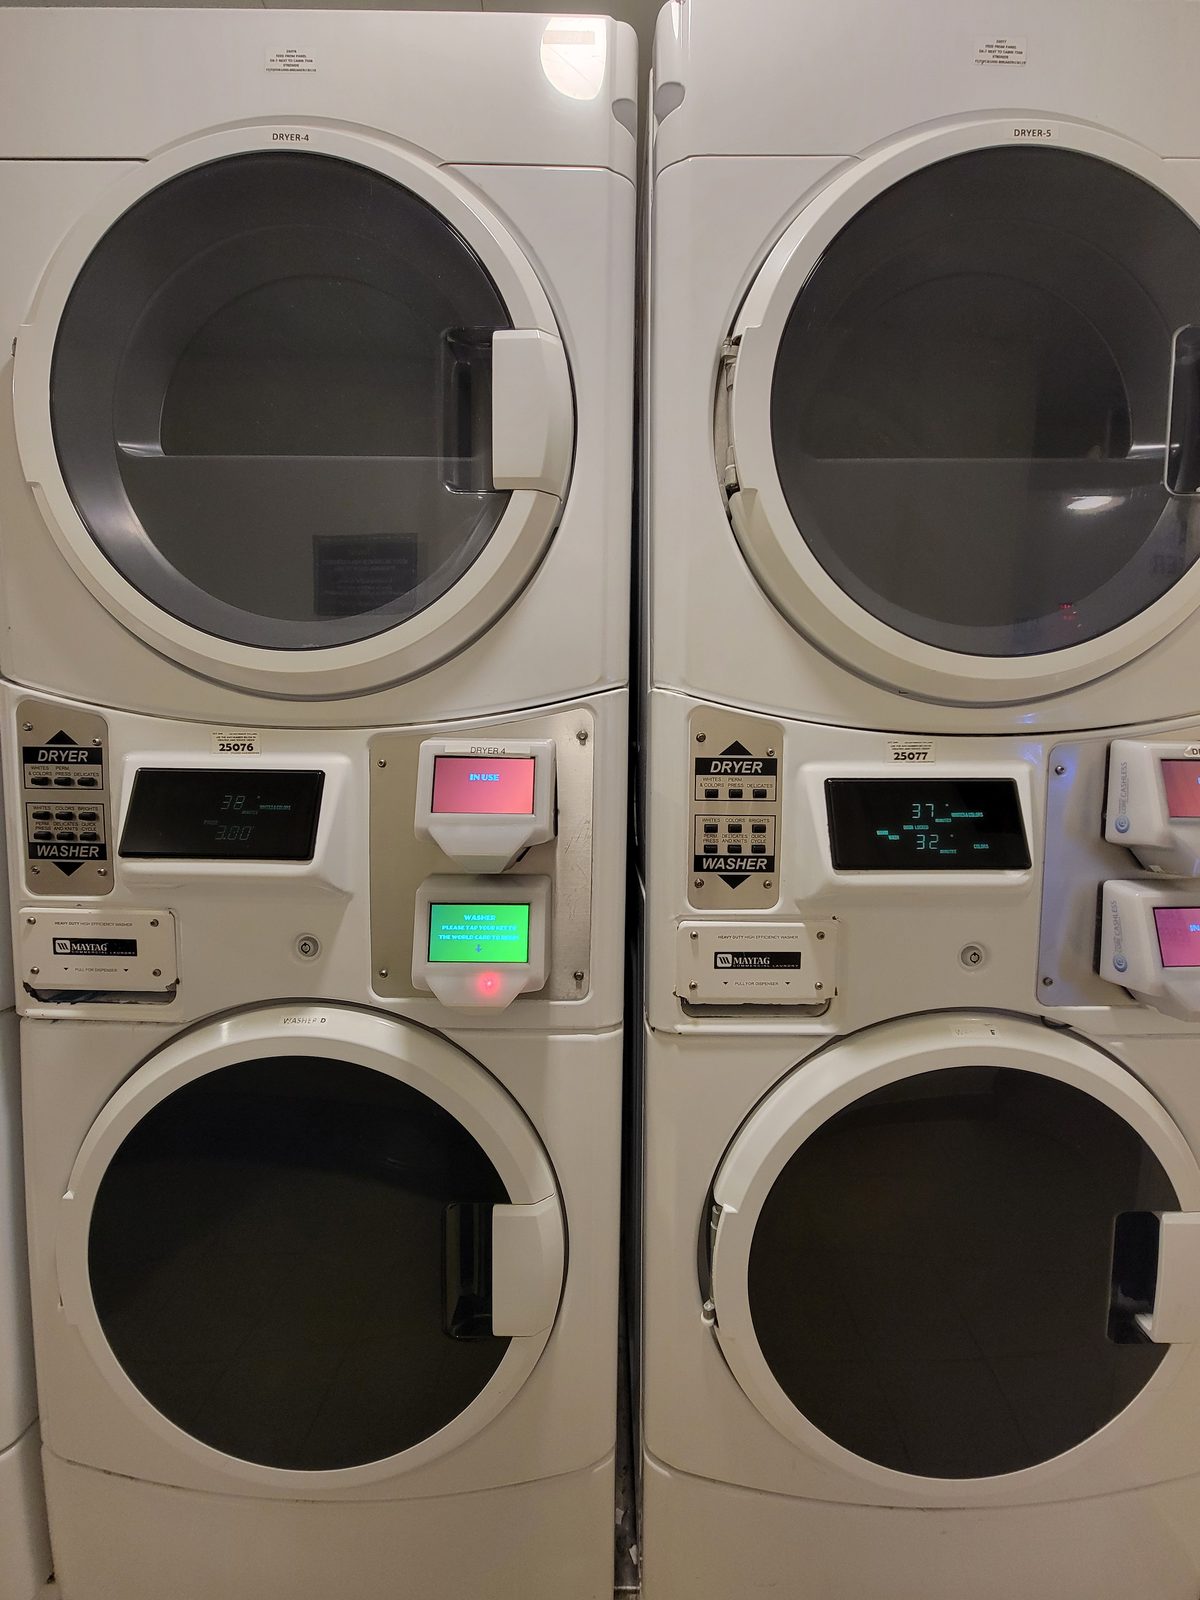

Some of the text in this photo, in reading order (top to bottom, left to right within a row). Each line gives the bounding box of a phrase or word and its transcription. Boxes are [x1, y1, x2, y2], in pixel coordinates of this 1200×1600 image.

[272, 132, 309, 142] DRYER-4
[1013, 128, 1052, 137] DRYER-5
[218, 742, 254, 752] 25076
[470, 746, 506, 755] DRYER 4
[37, 750, 89, 762] DRYER
[893, 752, 929, 760] 25077
[710, 760, 764, 774] DRYER
[469, 773, 500, 781] IN USE
[1120, 761, 1128, 798] CASHLESS
[220, 794, 246, 810] 38
[912, 804, 934, 819] 37
[916, 834, 939, 850] 32
[36, 844, 100, 858] WASHER
[702, 858, 768, 870] WASHER
[71, 942, 108, 951] MAYTAG
[733, 956, 770, 964] MAYTAG
